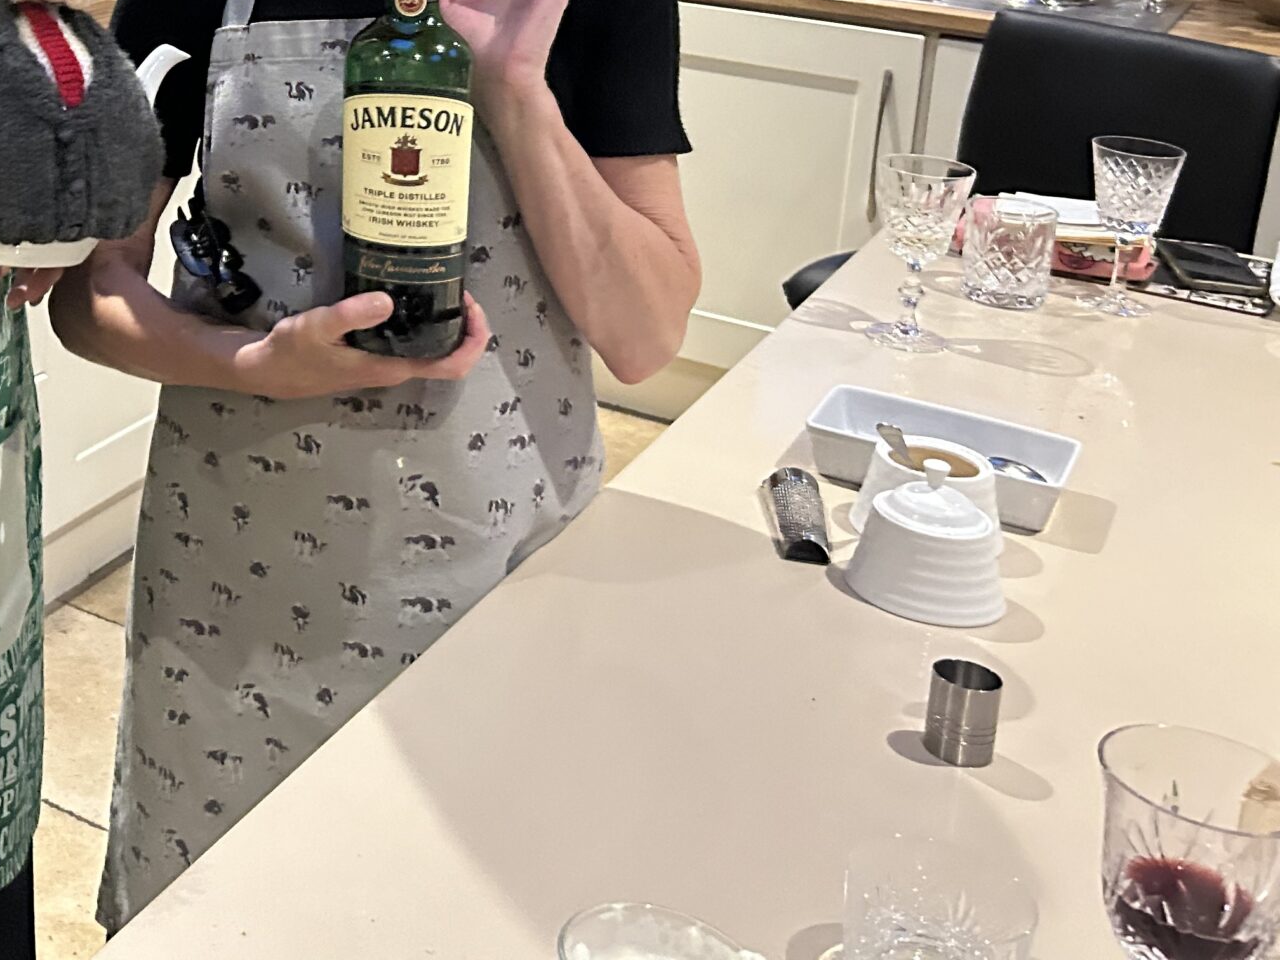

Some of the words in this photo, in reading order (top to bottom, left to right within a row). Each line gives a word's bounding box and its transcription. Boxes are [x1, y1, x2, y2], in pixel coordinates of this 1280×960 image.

[351, 106, 464, 137] JAMESON
[363, 187, 395, 199] TRIPLE
[398, 192, 446, 201] DISTILLED
[369, 216, 394, 227] IRISH
[395, 219, 440, 228] WHISKEY
